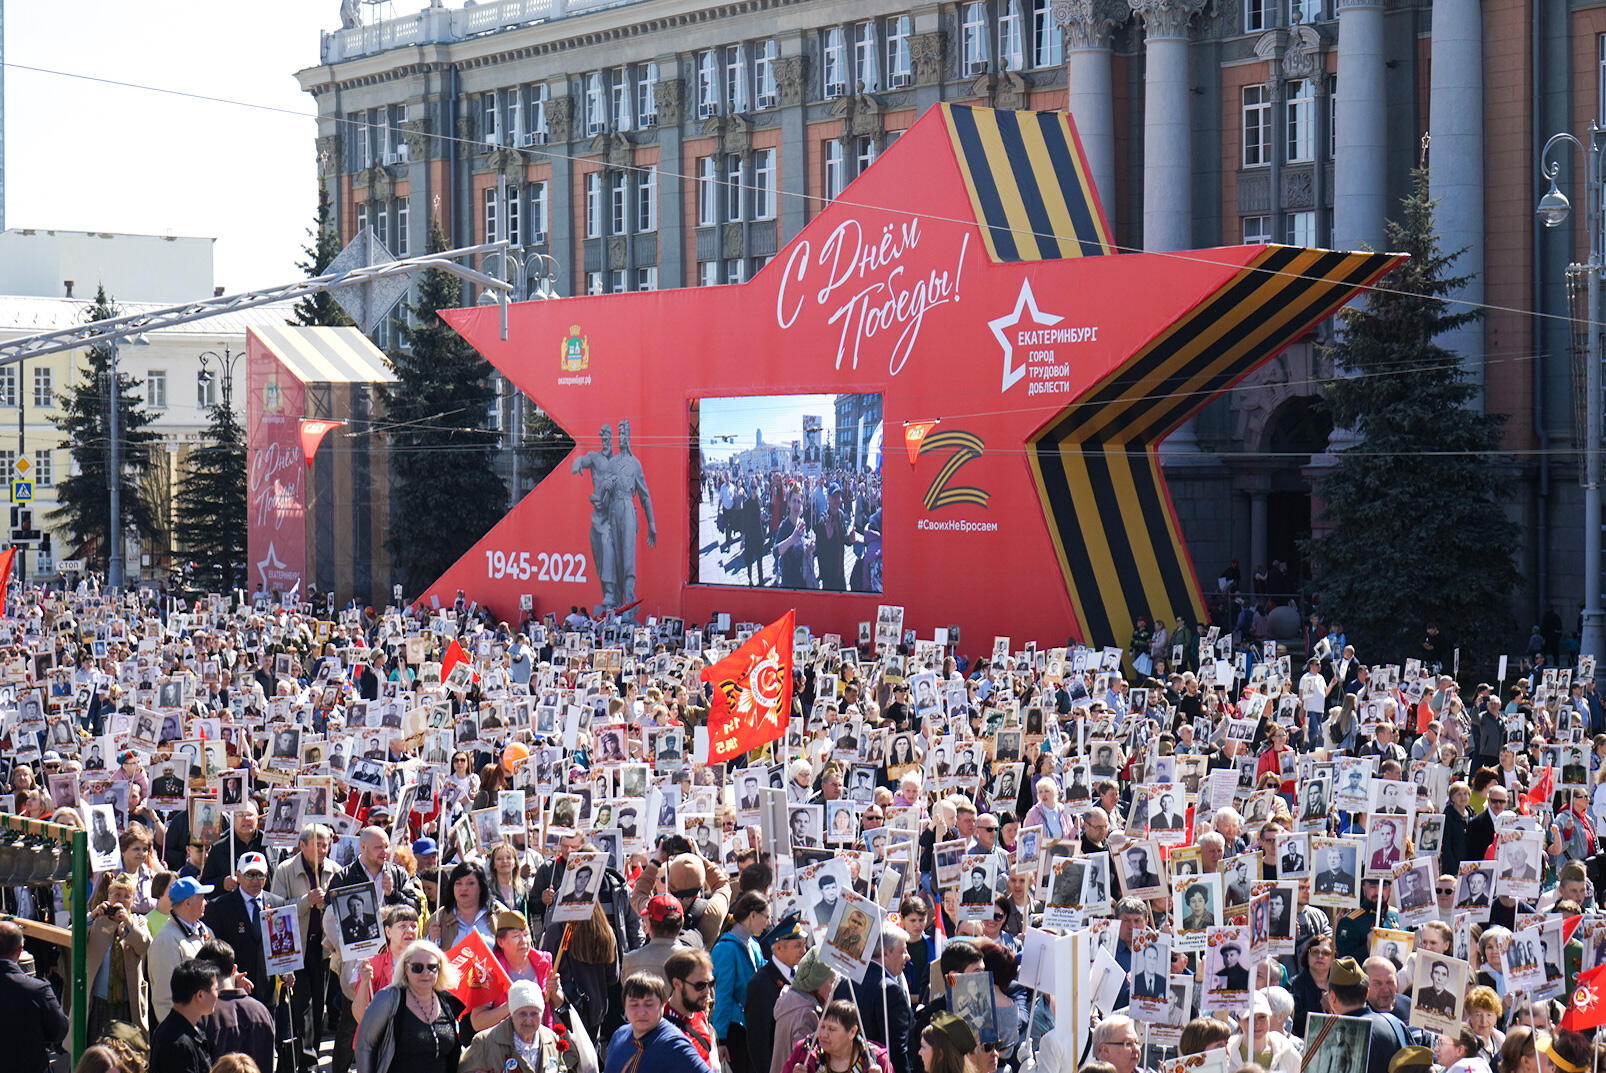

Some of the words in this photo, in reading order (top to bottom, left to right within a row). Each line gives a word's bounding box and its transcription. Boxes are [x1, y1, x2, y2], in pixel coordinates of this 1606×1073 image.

[777, 240, 811, 329] С
[817, 217, 922, 304] Днём
[828, 232, 970, 376] Победы!
[1017, 326, 1099, 346] ЕКАТЕРИНБУРГ
[1028, 350, 1055, 364] ГОРОД
[1028, 362, 1070, 380] ТРУДОВОЙ
[1028, 381, 1070, 396] ДОБЛЕСТИ
[917, 519, 998, 532] #СвоихНеБросаем
[485, 550, 587, 583] 1945-2022
